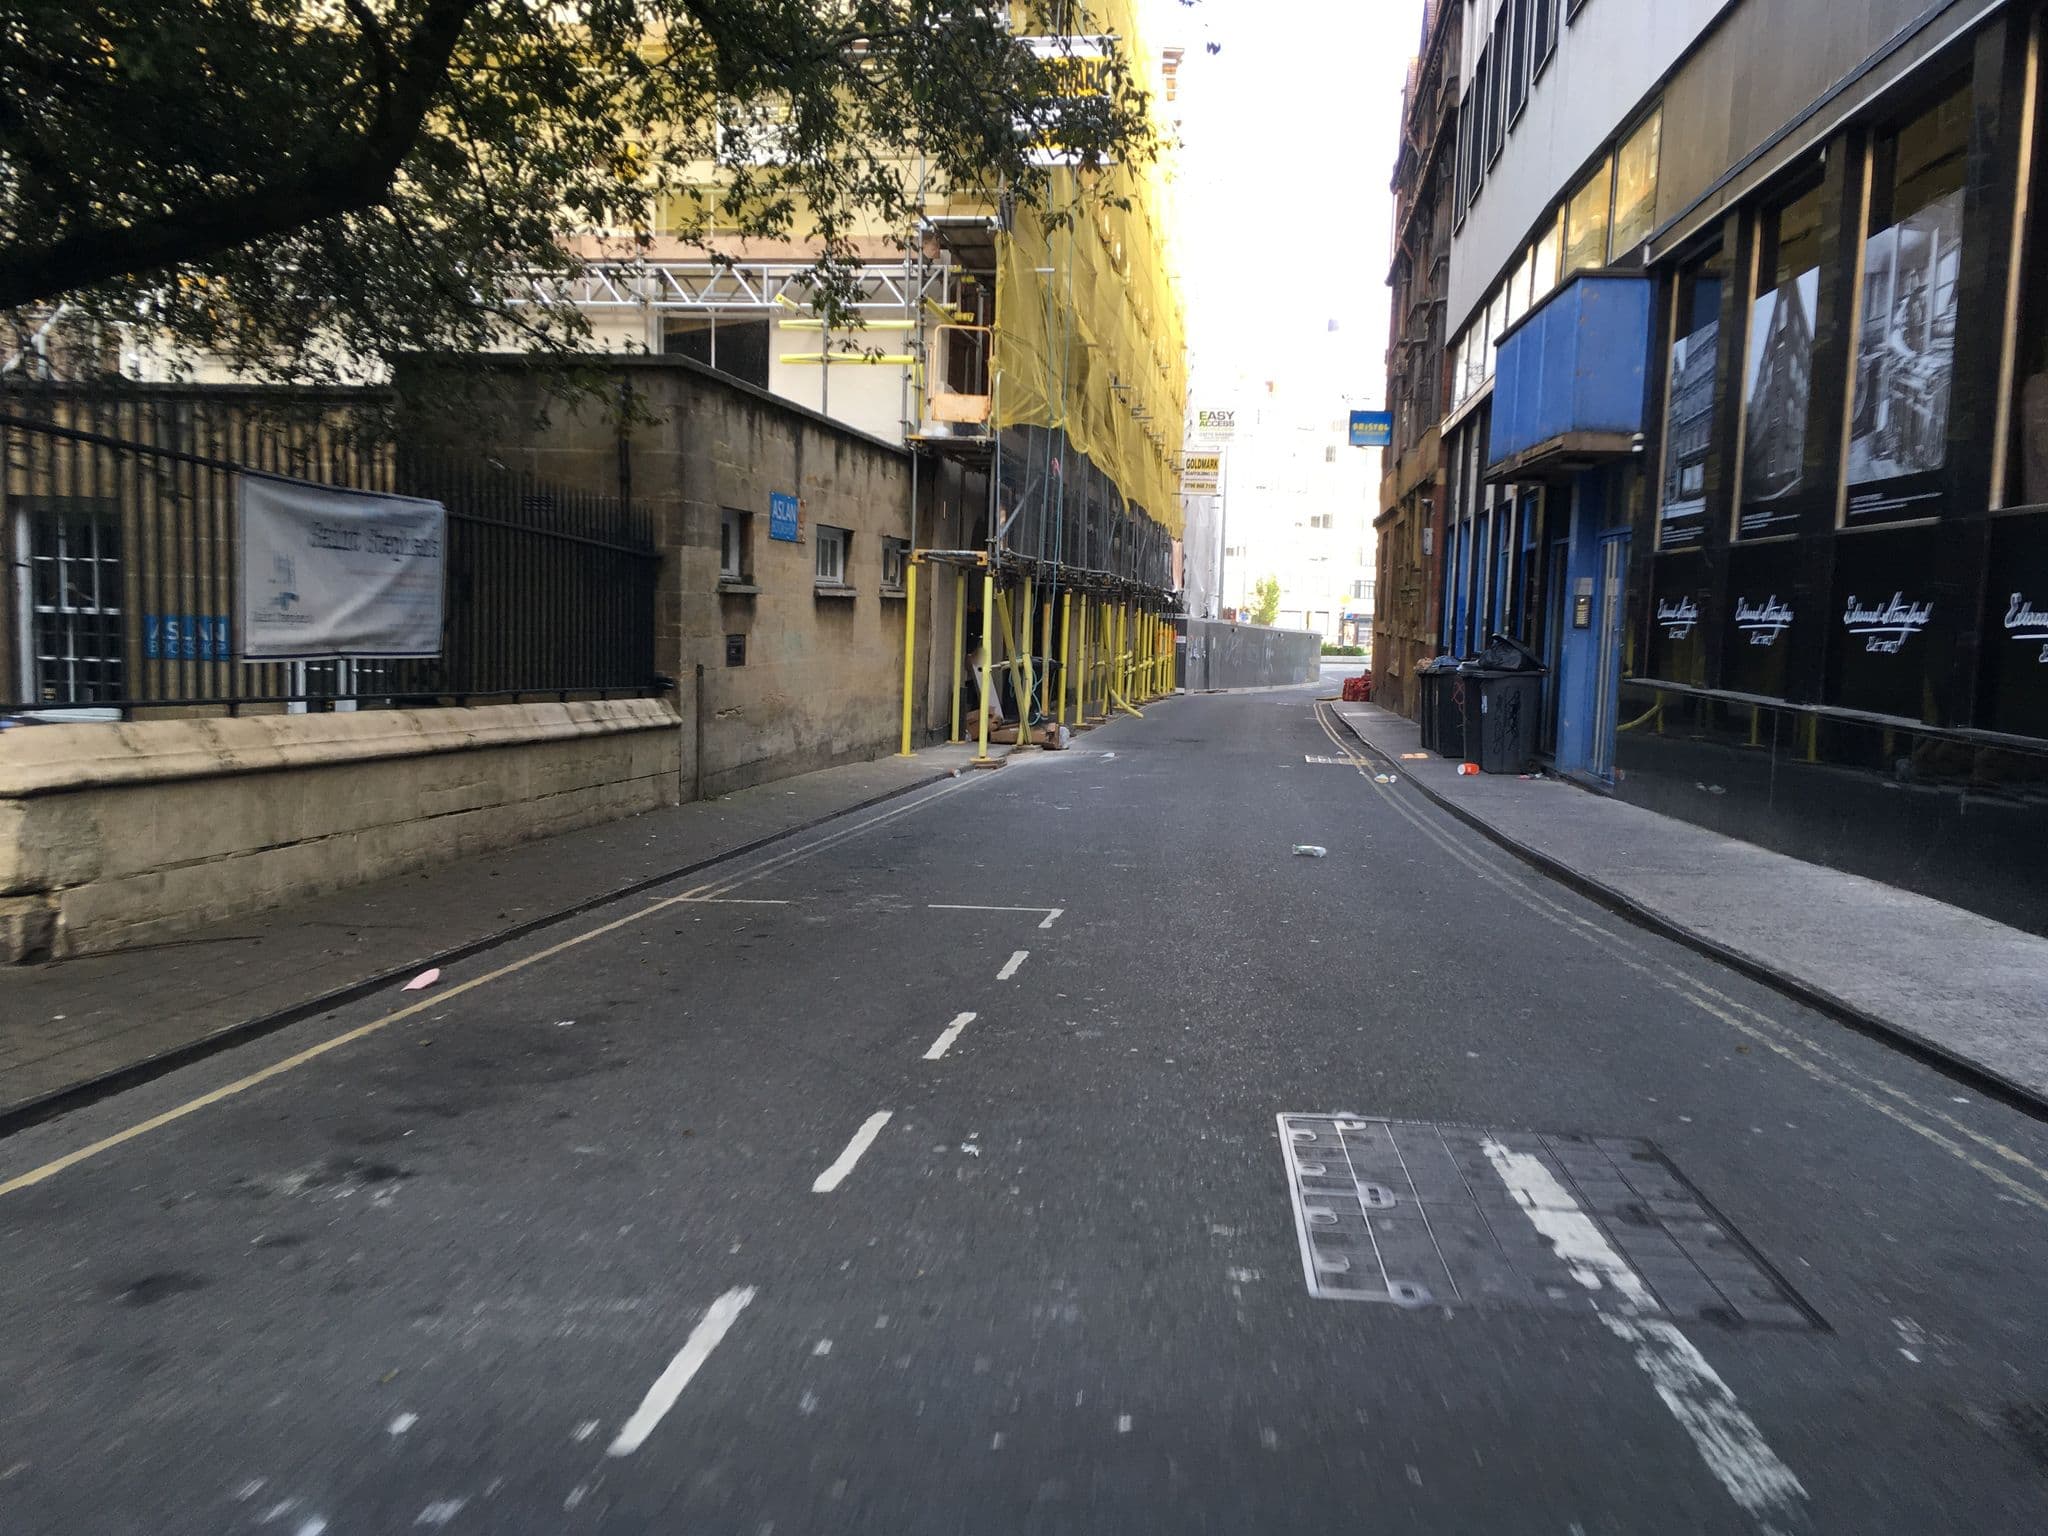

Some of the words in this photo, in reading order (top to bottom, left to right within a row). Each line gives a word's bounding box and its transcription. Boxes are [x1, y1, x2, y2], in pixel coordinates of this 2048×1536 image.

[1199, 411, 1235, 420] EASY
[1186, 458, 1218, 469] GOLDMARK
[772, 499, 797, 523] ASLAN
